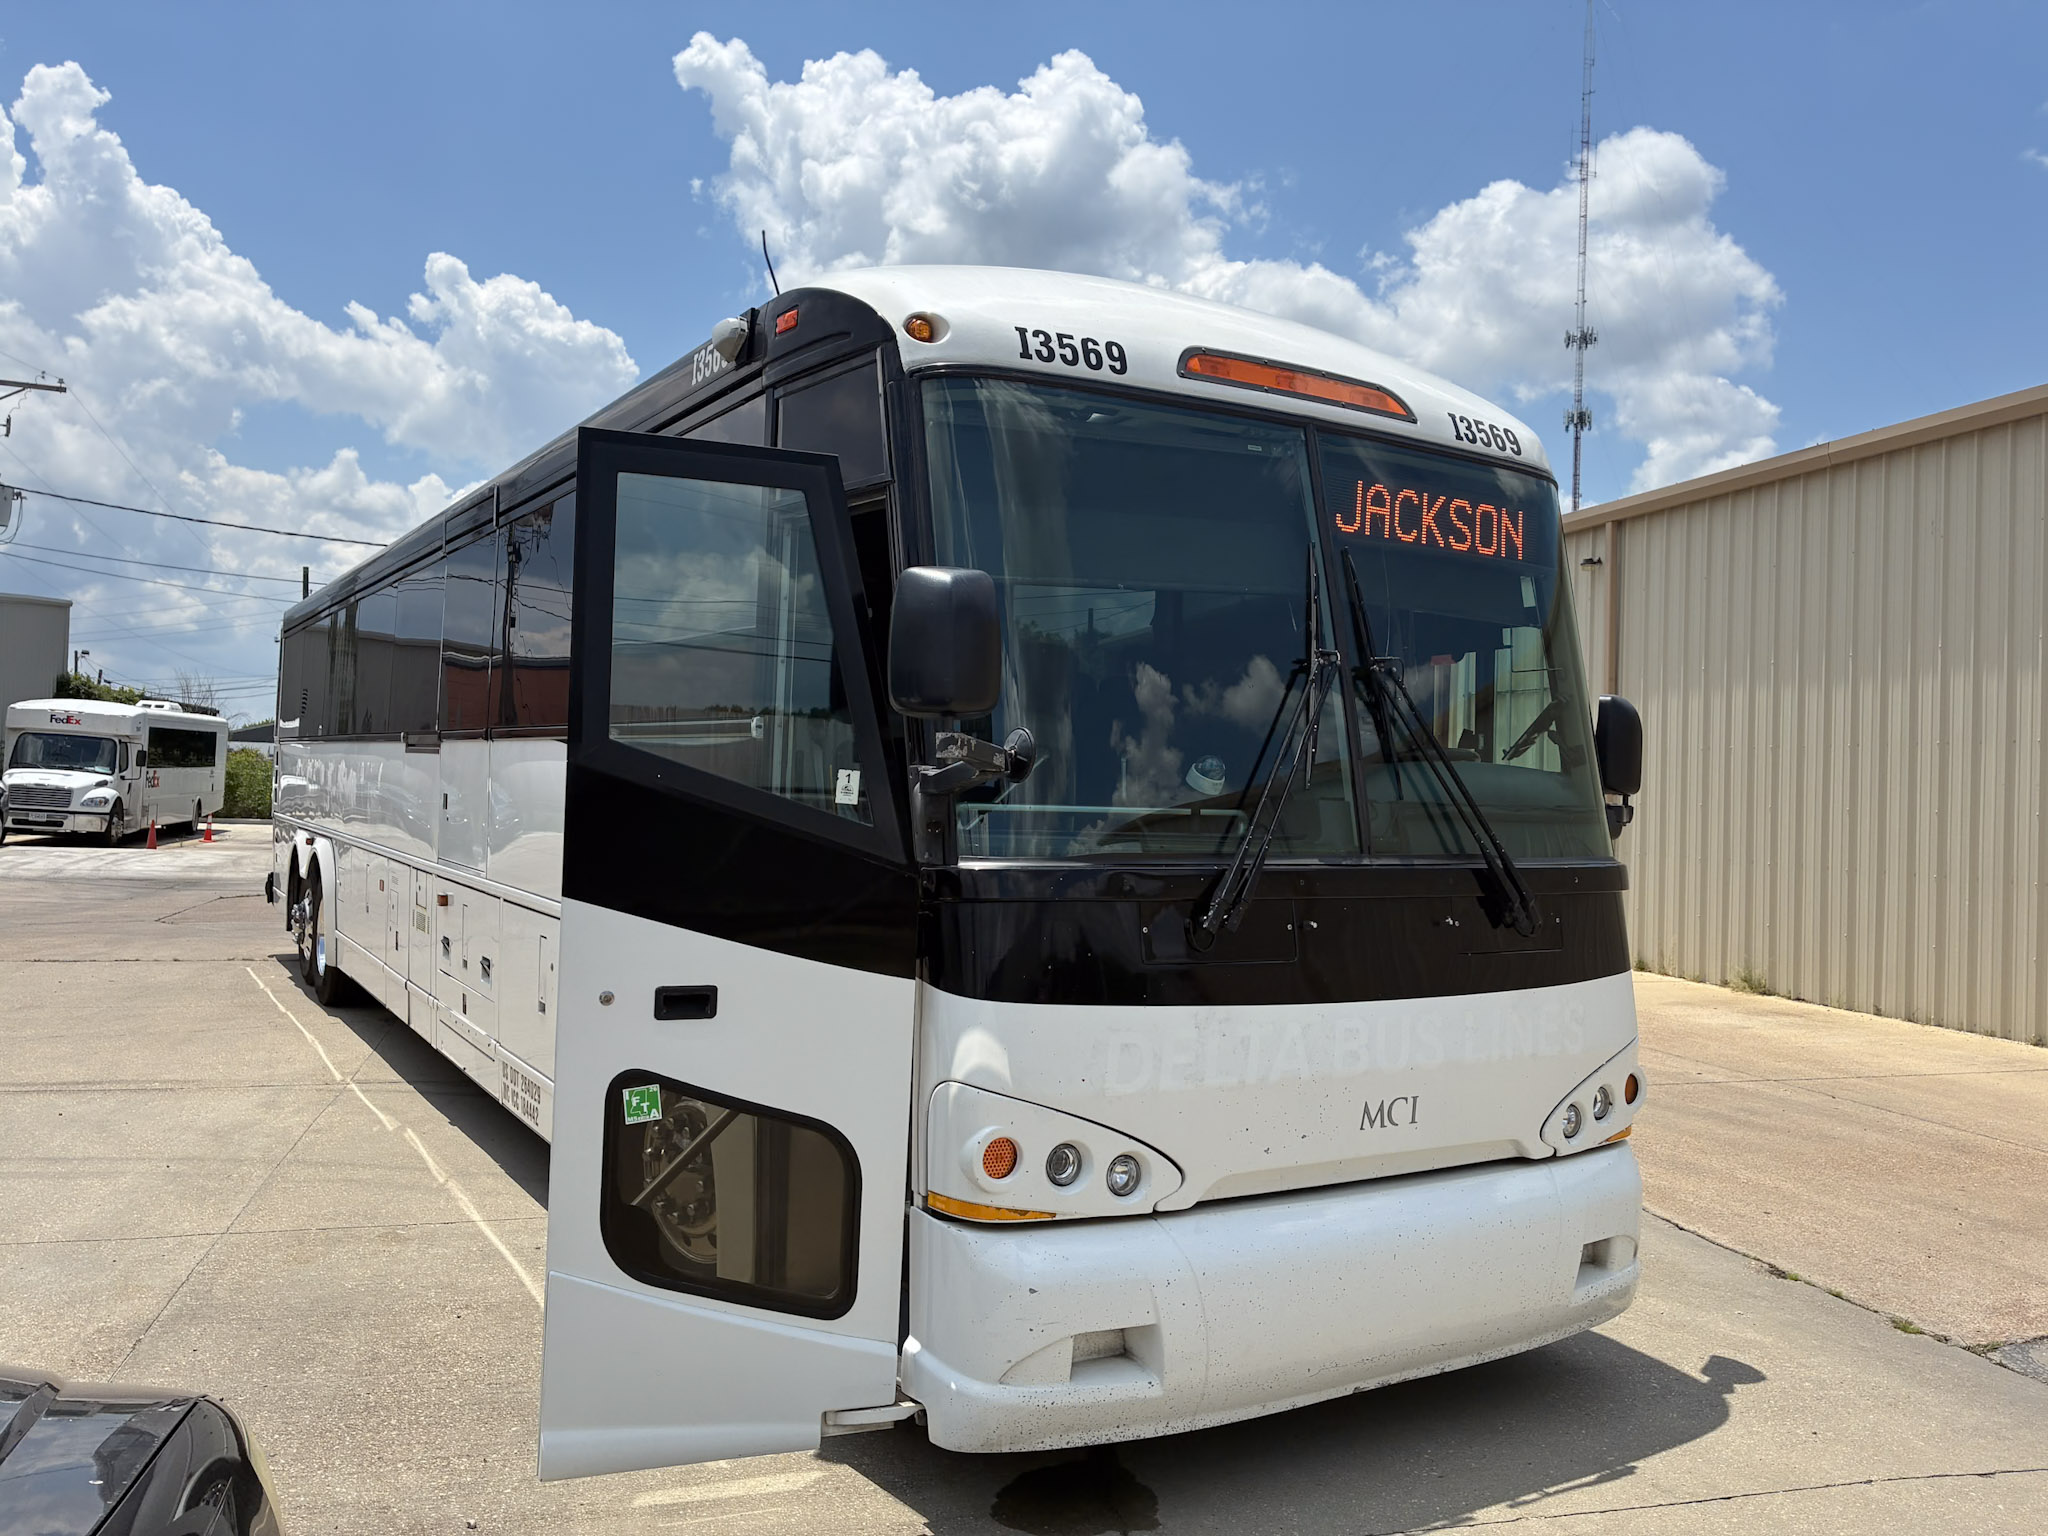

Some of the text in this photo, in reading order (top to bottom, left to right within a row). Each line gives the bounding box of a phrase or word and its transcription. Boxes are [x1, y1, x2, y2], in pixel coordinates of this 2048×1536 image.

[1015, 326, 1128, 376] I3569
[1448, 412, 1522, 456] I3569
[1336, 480, 1523, 560] JACKSON
[50, 714, 81, 725] FedEx
[845, 773, 851, 784] 1
[1104, 1005, 1585, 1097] DELTA BUS LINES
[1359, 1096, 1420, 1131] MCI
